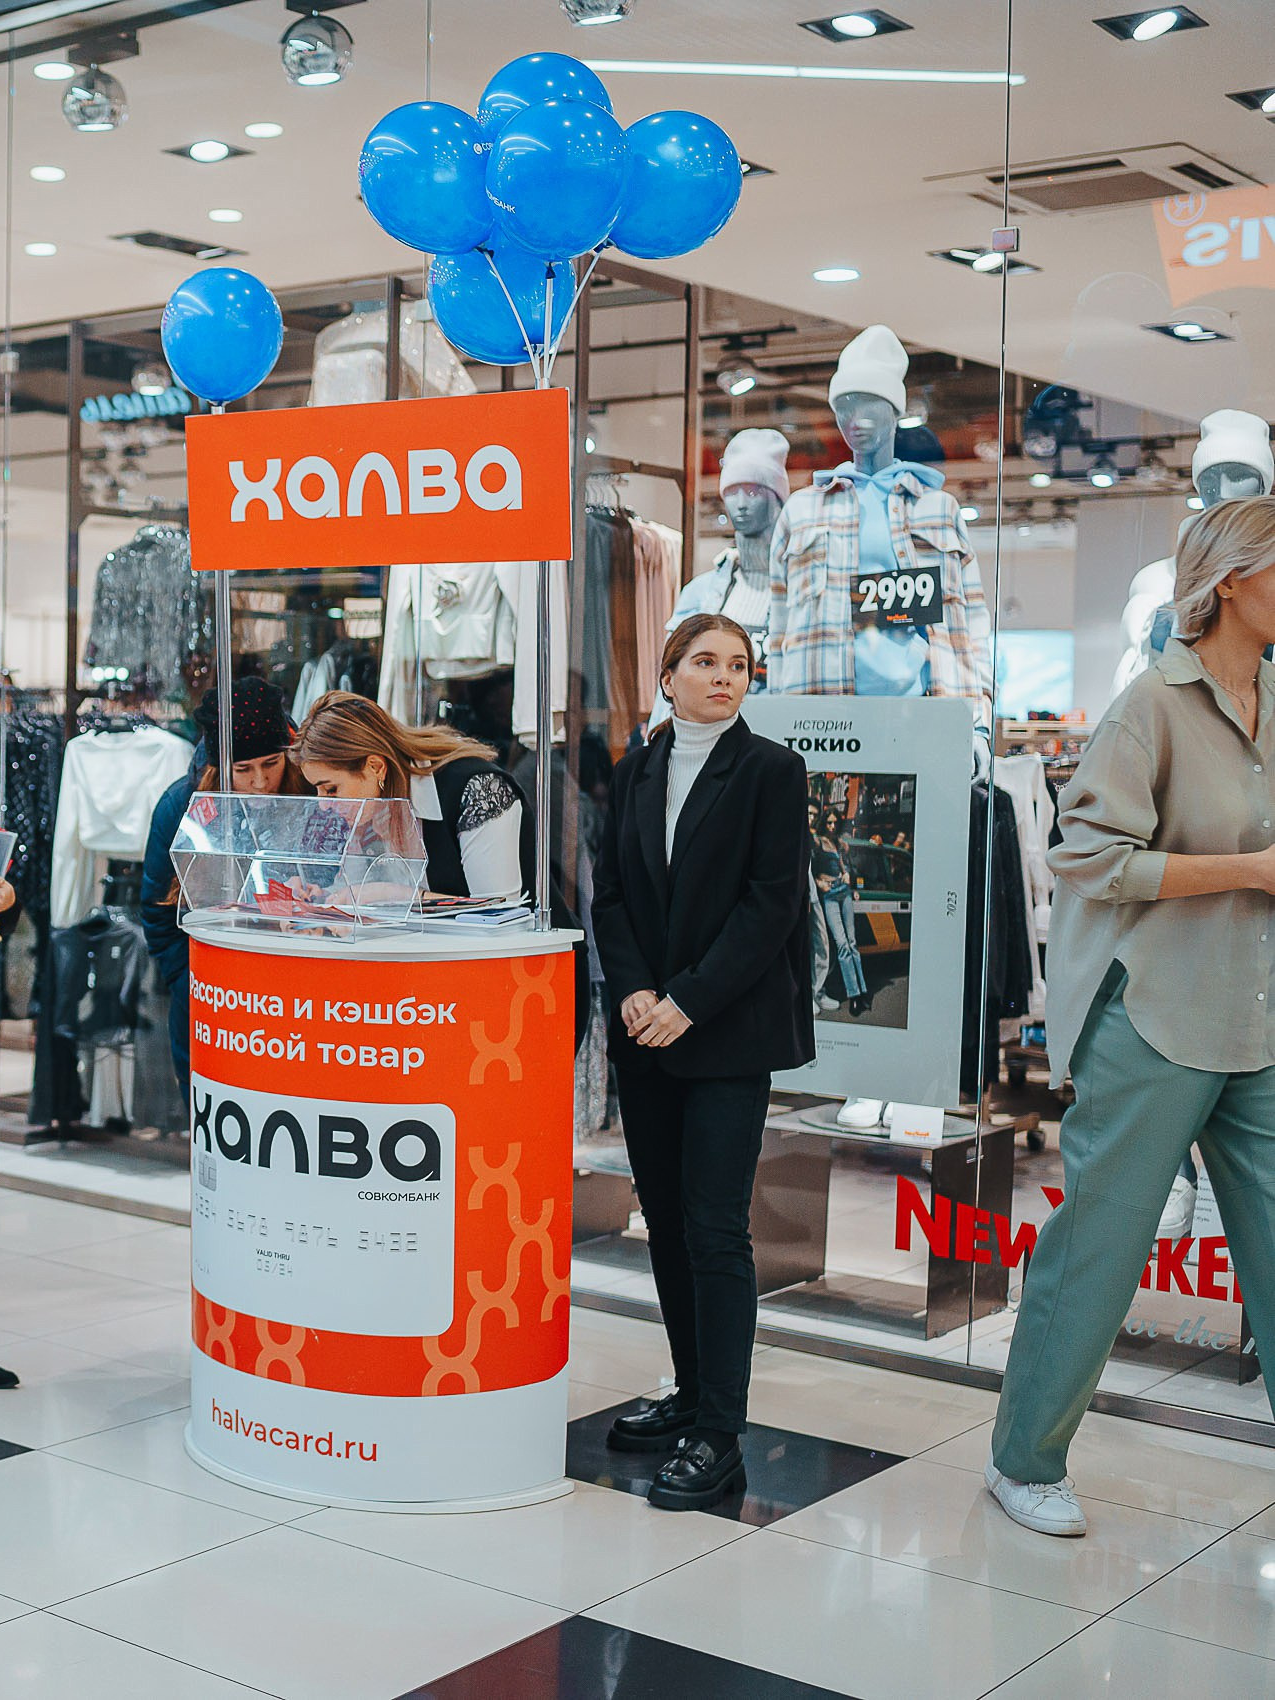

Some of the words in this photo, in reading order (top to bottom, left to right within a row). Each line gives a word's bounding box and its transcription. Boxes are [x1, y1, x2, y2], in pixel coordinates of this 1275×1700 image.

[859, 573, 935, 612] 2999
[793, 720, 853, 733] истории
[293, 998, 313, 1020] и
[324, 997, 457, 1025] кэшбэк
[195, 1020, 211, 1045] на
[215, 1028, 306, 1062] любой
[317, 1042, 425, 1075] товар
[357, 1190, 441, 1202] СОВКОМБАНК
[256, 1248, 273, 1258] VALID
[273, 1252, 291, 1262] THRU
[212, 1398, 378, 1462] halvacard.ru
